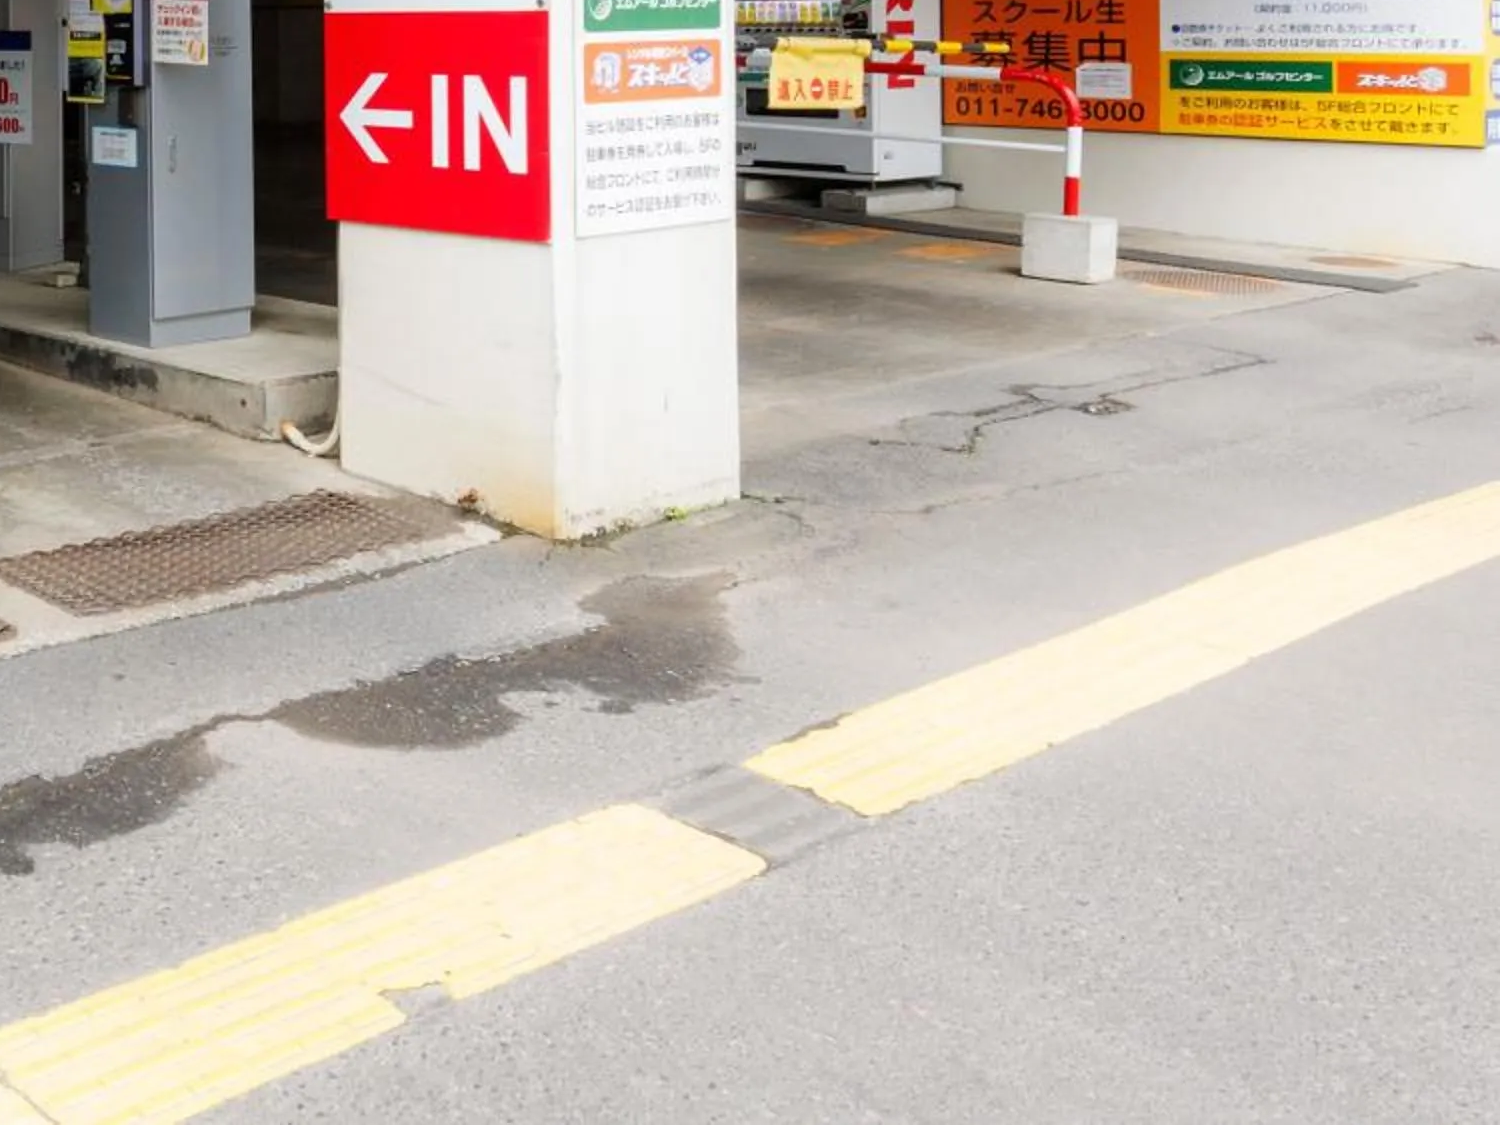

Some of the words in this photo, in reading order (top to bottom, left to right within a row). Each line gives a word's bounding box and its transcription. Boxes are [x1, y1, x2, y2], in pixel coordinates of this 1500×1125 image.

[970, 30, 1127, 72] 募集中
[431, 73, 528, 176] IN
